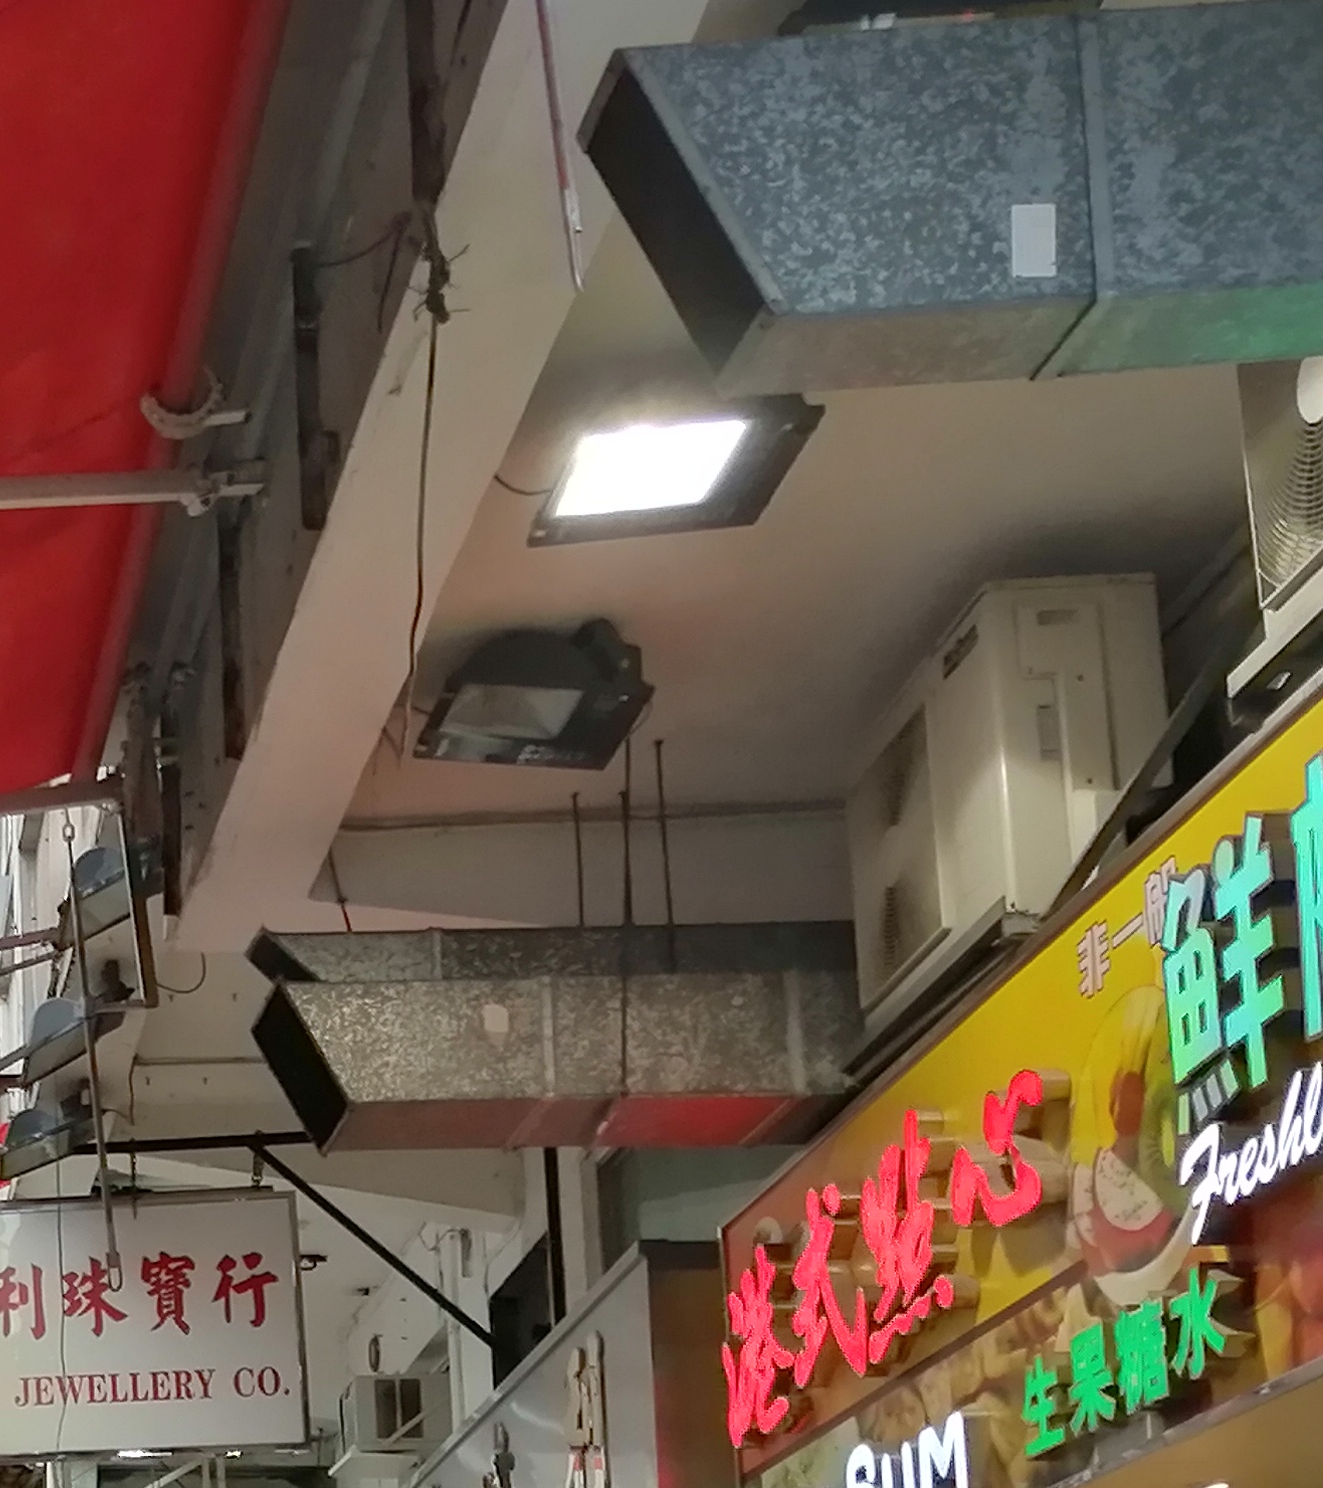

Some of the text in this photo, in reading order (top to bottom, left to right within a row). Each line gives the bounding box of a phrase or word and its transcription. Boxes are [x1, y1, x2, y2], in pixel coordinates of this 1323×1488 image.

[721, 1069, 1043, 1449] 港式點心
[14, 1367, 216, 1409] JEWELLERY
[232, 1365, 291, 1399] CO.
[1021, 1267, 1227, 1459] 生果糖水
